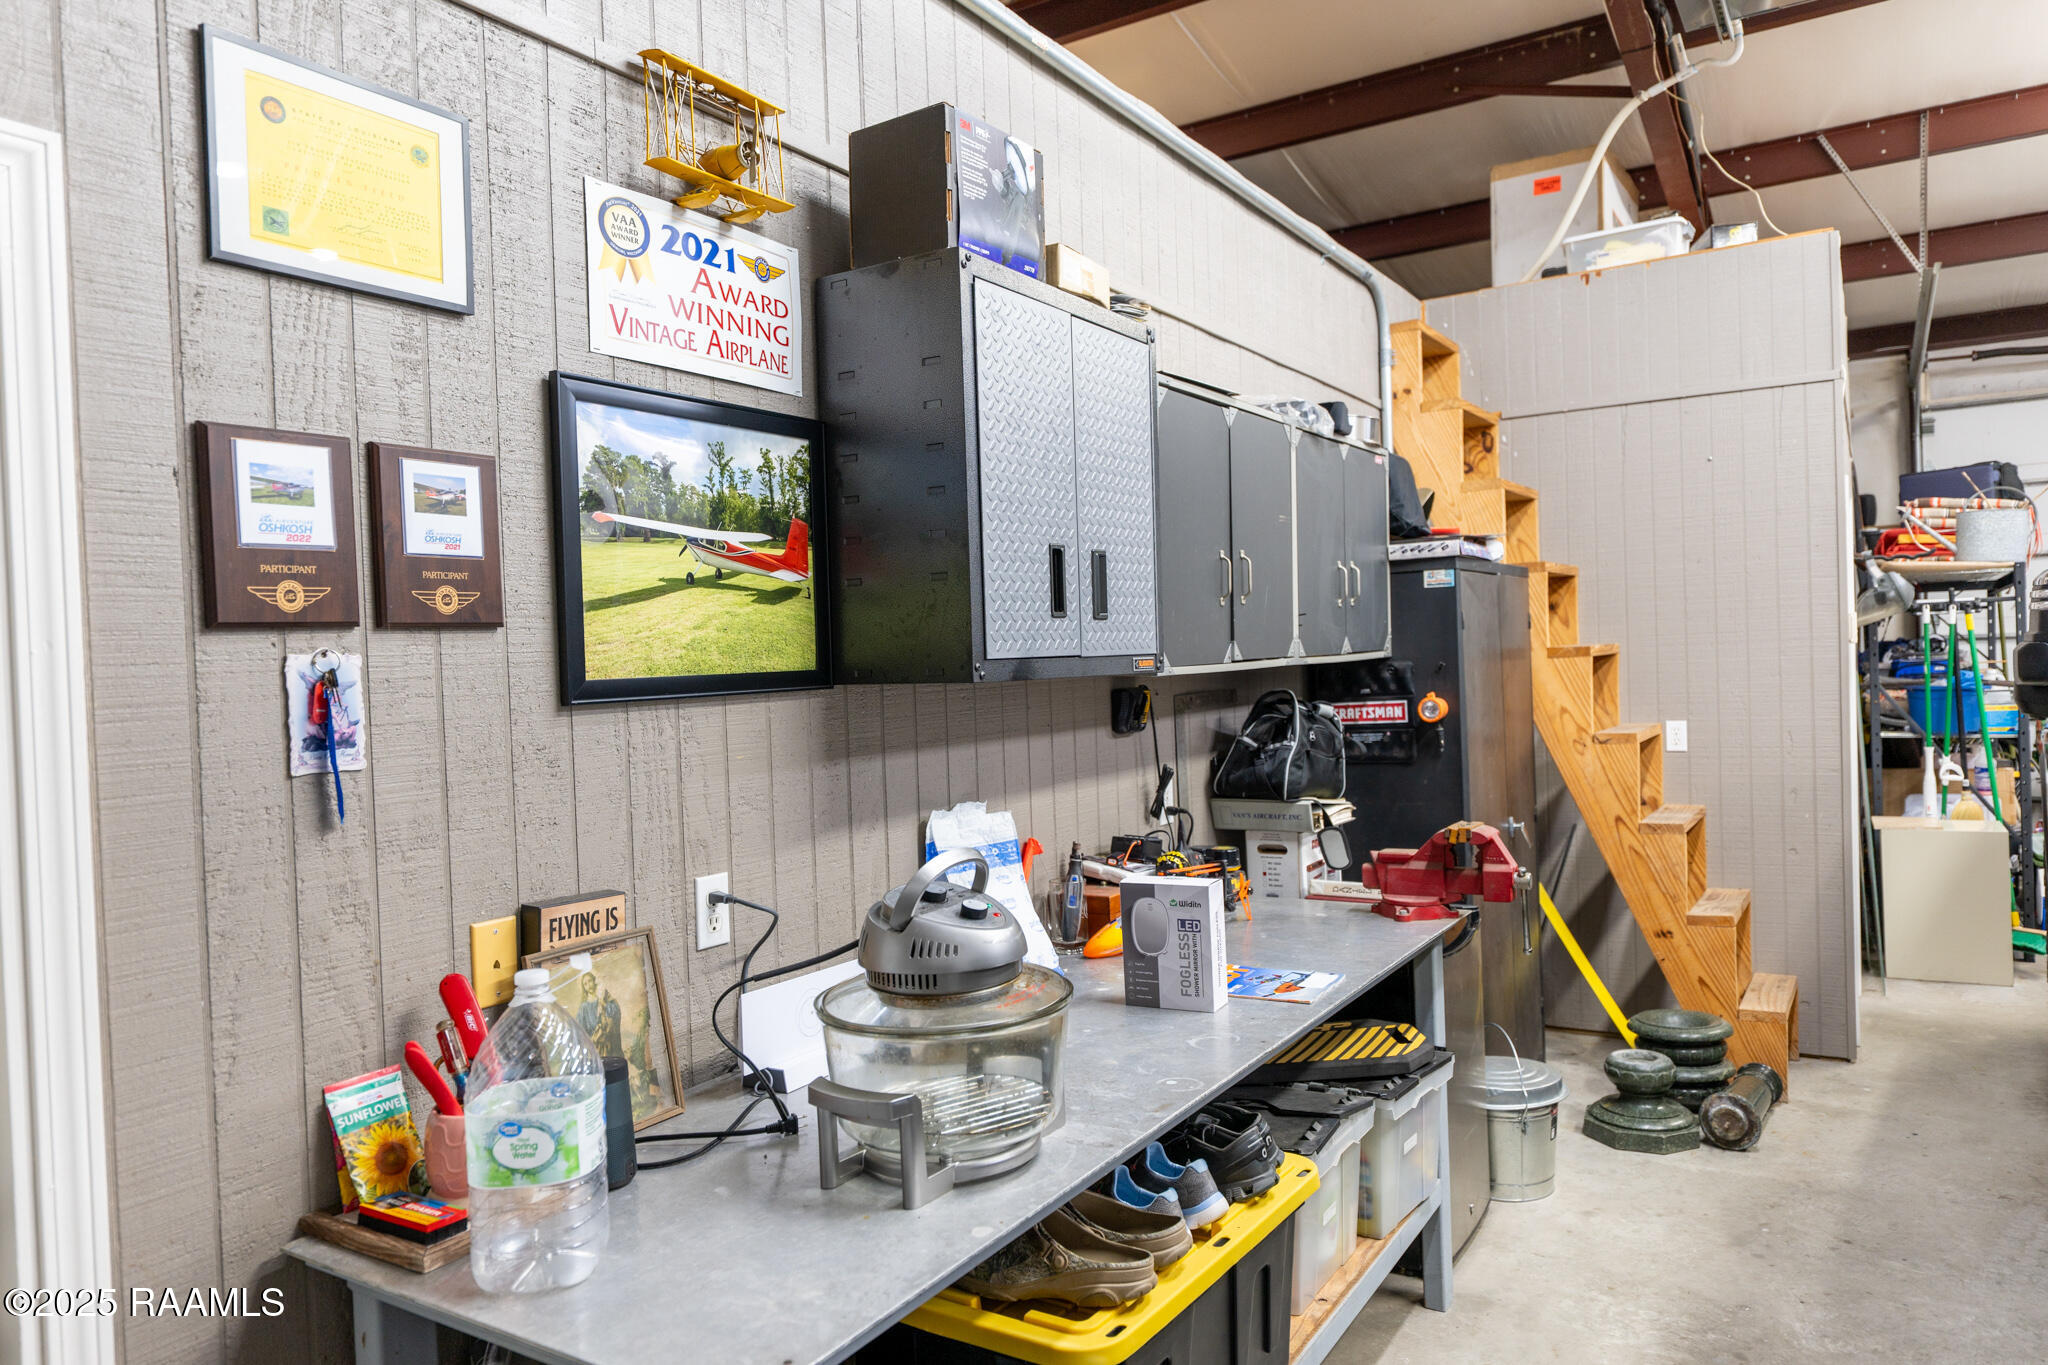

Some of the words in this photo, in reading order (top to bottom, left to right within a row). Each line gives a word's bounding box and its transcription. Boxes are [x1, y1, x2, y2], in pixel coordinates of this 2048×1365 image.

[612, 212, 636, 228] VAA
[611, 224, 639, 236] AWARD
[611, 231, 639, 245] WINNER
[660, 224, 736, 274] 2021
[691, 268, 789, 319] AWARD
[667, 294, 790, 347] WINNING
[608, 303, 697, 352] VINTAGE
[706, 330, 789, 375] AIRPLANE
[258, 522, 313, 535] OSHKOSH
[286, 534, 312, 543] 2022
[424, 535, 462, 544] OSHKOSH
[444, 543, 461, 551] 2021
[260, 564, 317, 575] PARTICIPANT
[422, 570, 469, 580] PARTICIPANT
[1178, 900, 1202, 909] Widitn
[549, 910, 600, 943] FLYING
[606, 906, 618, 931] IS
[1178, 920, 1201, 932] LED
[1178, 933, 1192, 997] FOGLESS
[509, 1143, 538, 1152] Spring
[512, 1150, 536, 1160] Water
